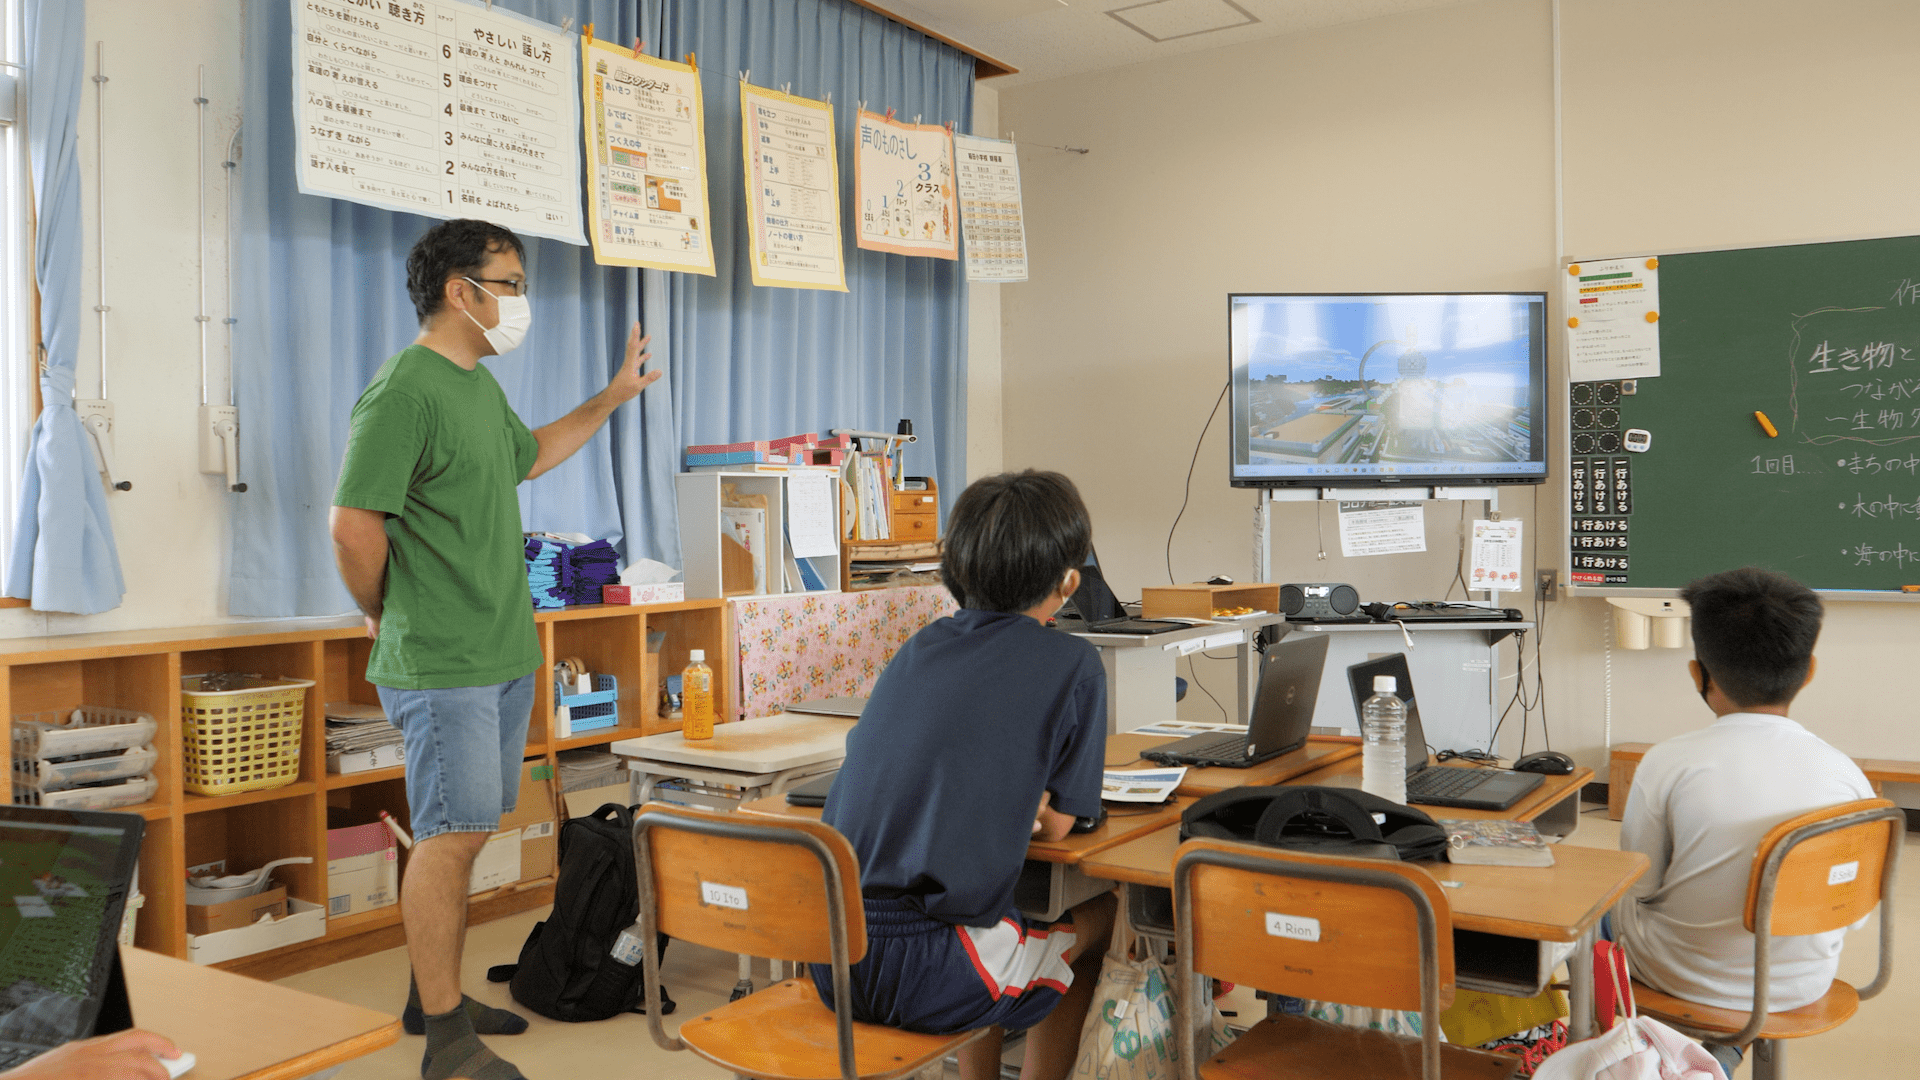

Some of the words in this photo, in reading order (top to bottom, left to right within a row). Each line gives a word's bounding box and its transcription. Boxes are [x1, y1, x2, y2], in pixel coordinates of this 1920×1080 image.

[306, 2, 379, 30] ともだちを助けられる
[388, 3, 425, 25] 聴き方
[333, 42, 377, 59] くらべながら
[442, 44, 452, 59] 6
[473, 28, 517, 50] やさしい
[522, 42, 552, 64] 話し方
[443, 73, 452, 88] 5
[530, 67, 546, 79] つけて
[459, 74, 498, 91] 理由をつけて
[605, 82, 631, 95] あいさつ
[444, 103, 453, 117] 4
[606, 109, 633, 122] ふでばこ
[310, 125, 342, 140] うなずき
[347, 134, 371, 147] ながら
[444, 131, 453, 146] 3
[609, 135, 642, 149] つくえの中
[861, 124, 917, 160] 声のものさし
[311, 159, 355, 176] 話す人を見て
[445, 160, 454, 175] 2
[460, 161, 517, 180] みんなの方を向いて
[610, 169, 637, 180] つくえの上
[918, 163, 931, 181] 3
[897, 180, 904, 197] 2
[916, 183, 940, 193] クラス
[447, 190, 453, 204] 1
[461, 194, 482, 205] 名前を
[486, 199, 520, 212] よばれたら
[883, 195, 887, 208] 1
[546, 213, 563, 221] はい！
[1809, 340, 1916, 374] 生き物と
[1751, 454, 1795, 475] 1回目
[1848, 452, 1920, 476] まちの中
[1573, 460, 1585, 512] 一行あける
[1594, 460, 1606, 512] 一行あける
[1615, 460, 1628, 512] 一行あける
[1572, 574, 1603, 582] かけられる数
[710, 890, 720, 901] 10
[723, 893, 739, 905] Ito
[1273, 921, 1281, 932] 4
[1285, 923, 1312, 936] Rion
